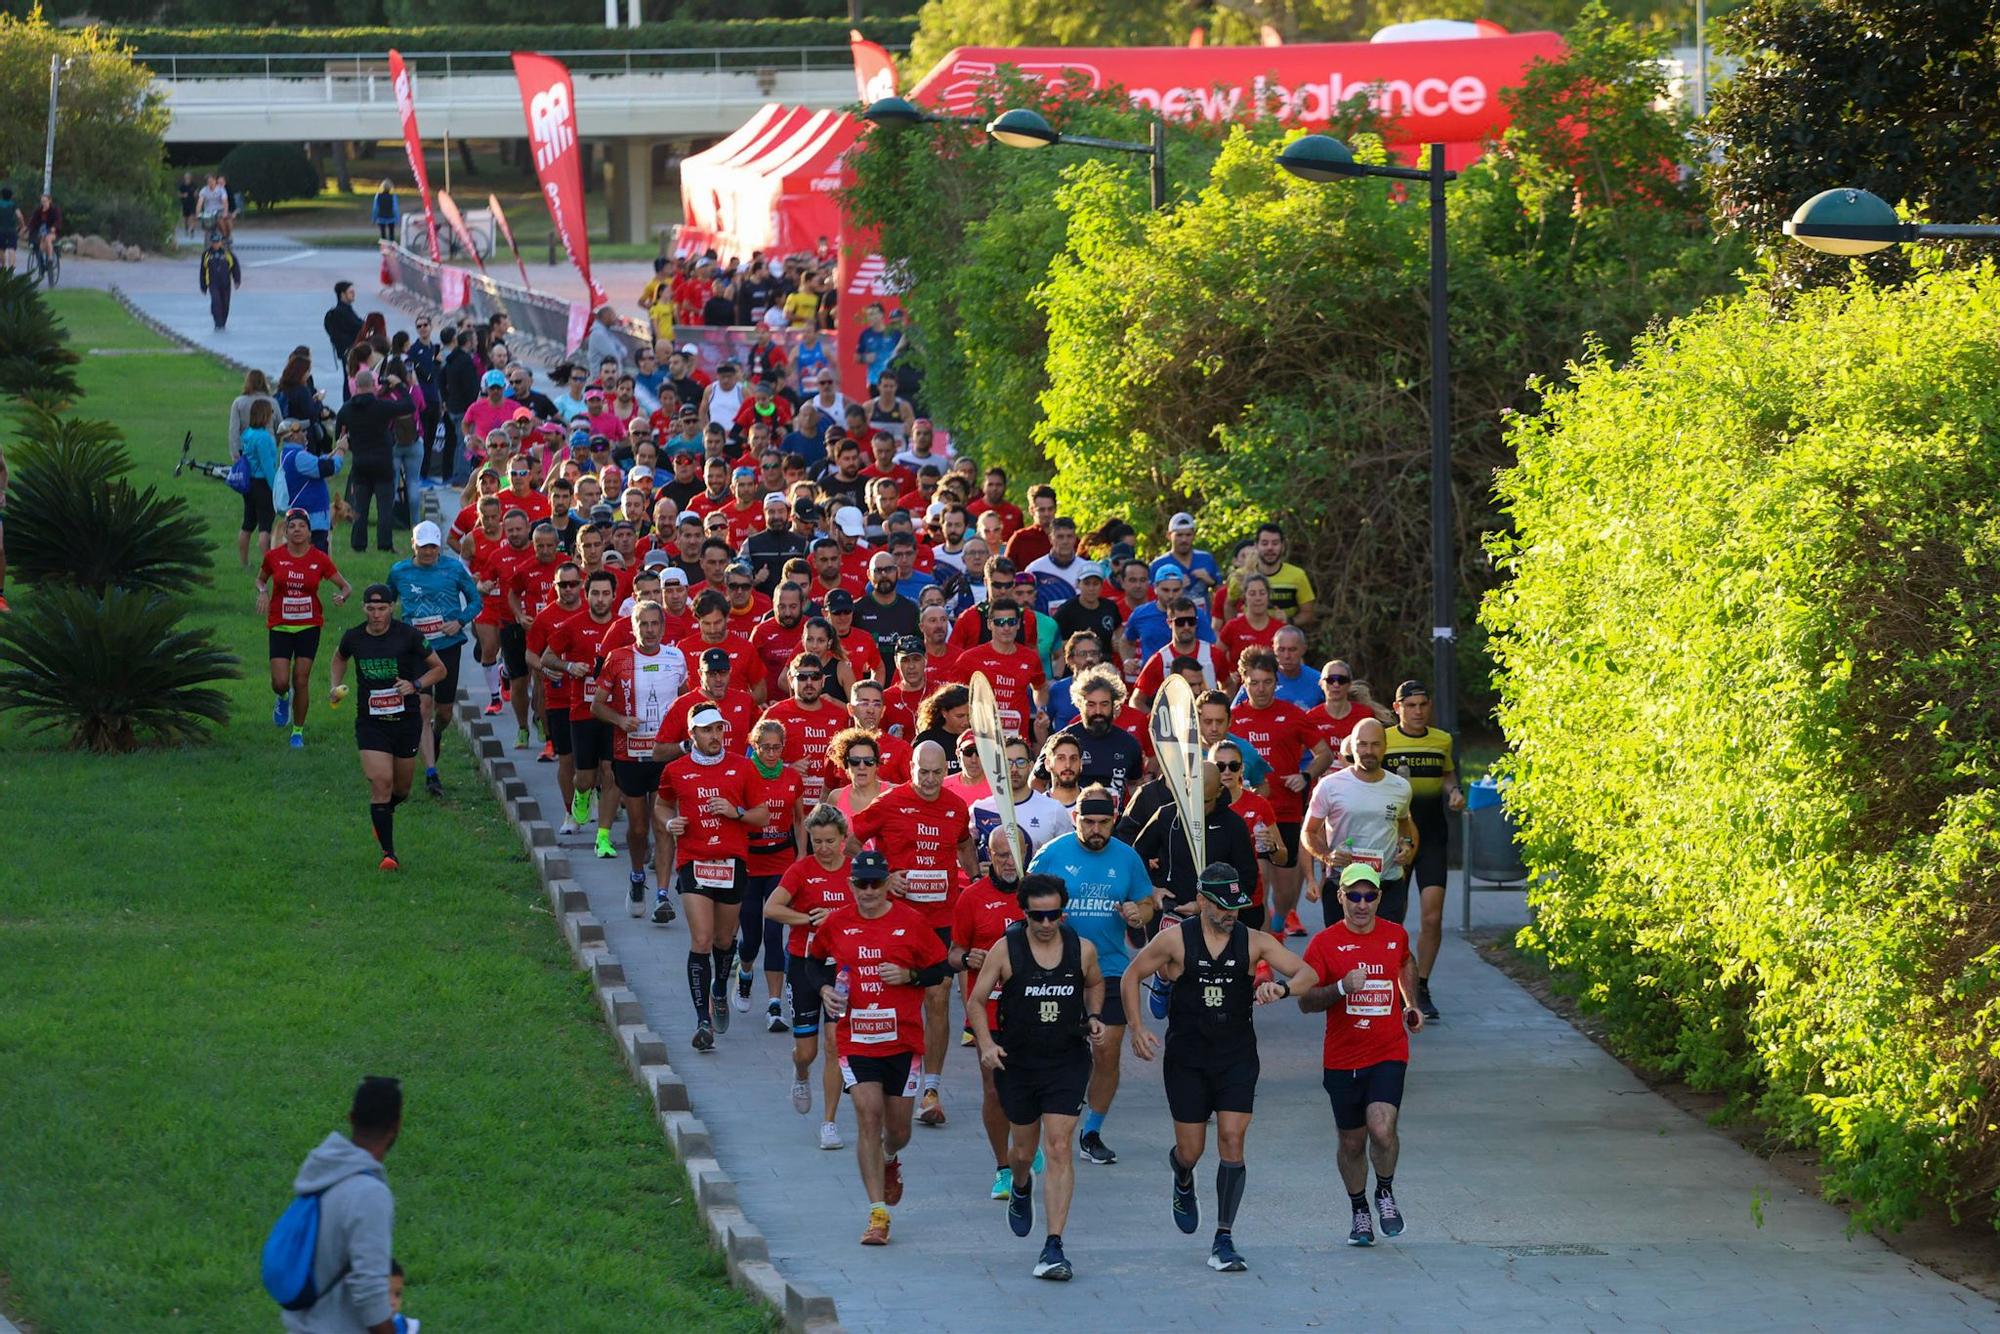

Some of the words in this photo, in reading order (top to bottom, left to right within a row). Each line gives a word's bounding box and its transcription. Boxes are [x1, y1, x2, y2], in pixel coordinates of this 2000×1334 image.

[288, 571, 304, 579] Run
[996, 674, 1015, 686] Run
[805, 726, 827, 738] Run
[1248, 731, 1270, 742] Run
[803, 743, 827, 756] your
[697, 787, 720, 798] Run
[701, 818, 722, 830] way.
[917, 823, 939, 836] Run
[916, 841, 940, 852] your
[916, 855, 936, 867] way.
[697, 867, 715, 876] LONG
[716, 868, 731, 878] RUN
[910, 882, 929, 890] LONG
[930, 882, 945, 891] RUN
[823, 890, 845, 902] Run
[858, 945, 882, 959] Run
[1358, 962, 1384, 974] Run
[860, 982, 884, 996] way.
[1025, 983, 1074, 996] PRÁCTICO
[1351, 993, 1372, 1003] LONG
[1374, 993, 1390, 1003] RUN
[854, 1021, 874, 1031] LONG
[875, 1021, 892, 1031] RUN
